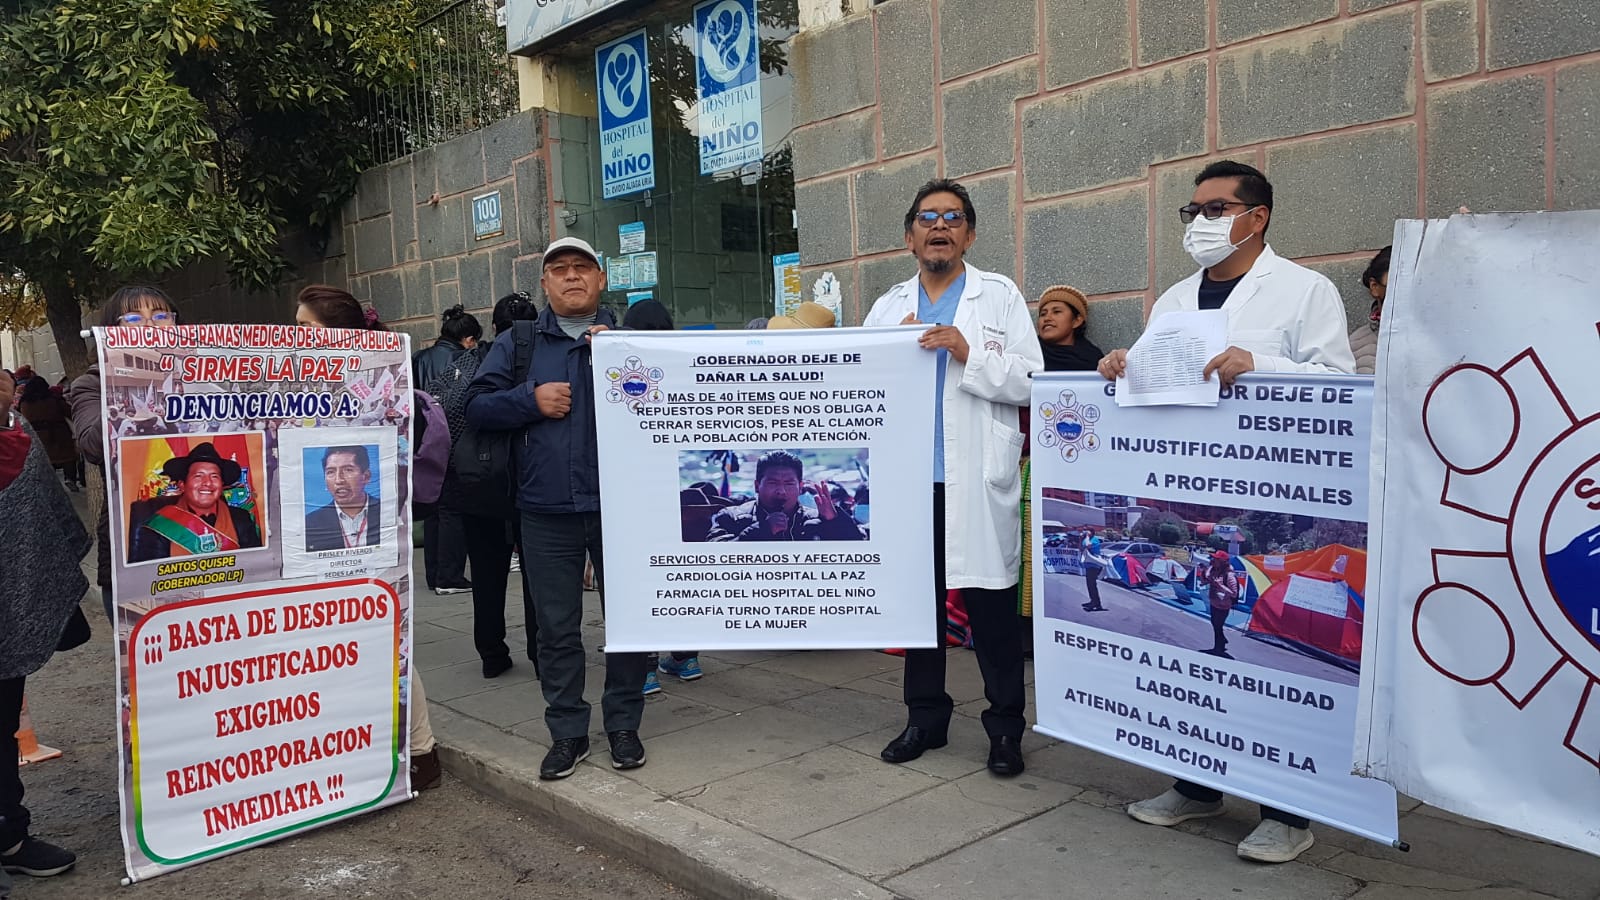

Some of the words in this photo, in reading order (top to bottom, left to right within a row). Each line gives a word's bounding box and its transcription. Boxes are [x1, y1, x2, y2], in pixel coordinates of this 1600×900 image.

[702, 86, 757, 114] HOSPITAL
[712, 113, 725, 128] del
[603, 122, 649, 146] HOSPITAL
[702, 121, 758, 153] NIÑO
[612, 145, 623, 158] del
[604, 153, 651, 180] NIÑO
[477, 198, 497, 221] 100
[106, 325, 177, 347] SINDICATO
[179, 326, 196, 347] DE
[200, 325, 240, 347] RAMAS
[243, 325, 294, 347] MEDICAS
[296, 326, 313, 347] DE
[315, 327, 351, 348] SALUD
[354, 329, 400, 350] PUBLICA
[182, 357, 263, 382] SIRMES
[266, 357, 295, 381] LA
[300, 357, 344, 381] PAZ
[693, 355, 797, 367] ¡GOBERNADOR
[801, 353, 838, 364] DEJE
[842, 353, 861, 364] DE
[696, 371, 745, 383] DAÑAR
[750, 372, 768, 382] LA
[771, 371, 824, 382] SALUD!
[667, 392, 695, 402] MAS
[699, 392, 716, 402] DE
[719, 391, 734, 401] 40
[737, 390, 775, 401] ÍTEMS
[779, 391, 806, 401] QUE
[809, 390, 829, 401] NO
[832, 390, 886, 400] FUERON
[1255, 385, 1314, 403] DEJE
[1322, 387, 1354, 404] DE
[166, 393, 331, 421] DENUNCIAMOS
[337, 393, 359, 417] A:
[636, 405, 714, 416] REPUESTOS
[717, 405, 744, 415] POR
[747, 405, 790, 415] SEDES
[793, 404, 821, 415] NOS
[824, 404, 873, 414] OBLIGA
[876, 403, 886, 413] A
[639, 420, 693, 430] CERRAR
[696, 419, 768, 431] SERVICIOS,
[771, 418, 804, 428] PESE
[808, 418, 825, 428] AL
[828, 417, 884, 428] CLAMOR
[1238, 414, 1354, 437] DESPEDIR
[653, 434, 670, 444] DE
[673, 434, 690, 443] LA
[694, 431, 769, 443] POBLACIÓN
[772, 432, 799, 442] POR
[802, 429, 871, 441] ATENCIÓN.
[1110, 436, 1353, 468] INJUSTIFICADAMENTE
[1145, 472, 1159, 487] A
[1164, 473, 1353, 506] PROFESIONALES
[158, 560, 197, 575] SANTOS
[199, 556, 236, 570] QUISPE
[650, 555, 716, 565] SERVICIOS
[719, 554, 789, 564] CERRADOS
[793, 554, 801, 563] Y
[804, 553, 881, 563] AFECTADOS
[227, 569, 244, 583] LP)
[666, 570, 752, 582] CARDIOLOGÍA
[756, 571, 818, 581] HOSPITAL
[821, 571, 837, 580] LA
[841, 571, 866, 580] PAZ
[656, 589, 721, 599] FARMACIA
[724, 589, 748, 598] DEL
[752, 589, 814, 598] HOSPITAL
[817, 588, 841, 598] DEL
[845, 586, 876, 598] NIÑO
[651, 605, 724, 617] ECOGRAFÍA
[727, 606, 771, 616] TURNO
[774, 606, 816, 616] TARDE
[819, 606, 881, 616] HOSPITAL
[168, 614, 242, 652] BASTA
[247, 608, 277, 637] DE
[283, 594, 388, 628] DESPIDOS
[725, 620, 742, 629] DE
[745, 620, 761, 629] LA
[765, 619, 807, 629] MUJER
[177, 641, 359, 699] INJUSTIFICADOS
[1054, 629, 1134, 661] RESPETO
[1139, 651, 1152, 667] A
[1158, 655, 1183, 674] LA
[1189, 663, 1335, 712] ESTABILIDAD
[1136, 676, 1228, 714] LABORAL
[215, 691, 321, 738] EXIGIMOS
[1065, 687, 1142, 722] ATIENDA
[1147, 711, 1172, 731] LA
[1177, 720, 1245, 752] SALUD
[1252, 741, 1281, 763] DE
[1288, 752, 1317, 774] LA
[166, 724, 373, 798] REINCORPORACION
[1115, 728, 1228, 776] POBLACION
[203, 780, 323, 836] INMEDIATA
